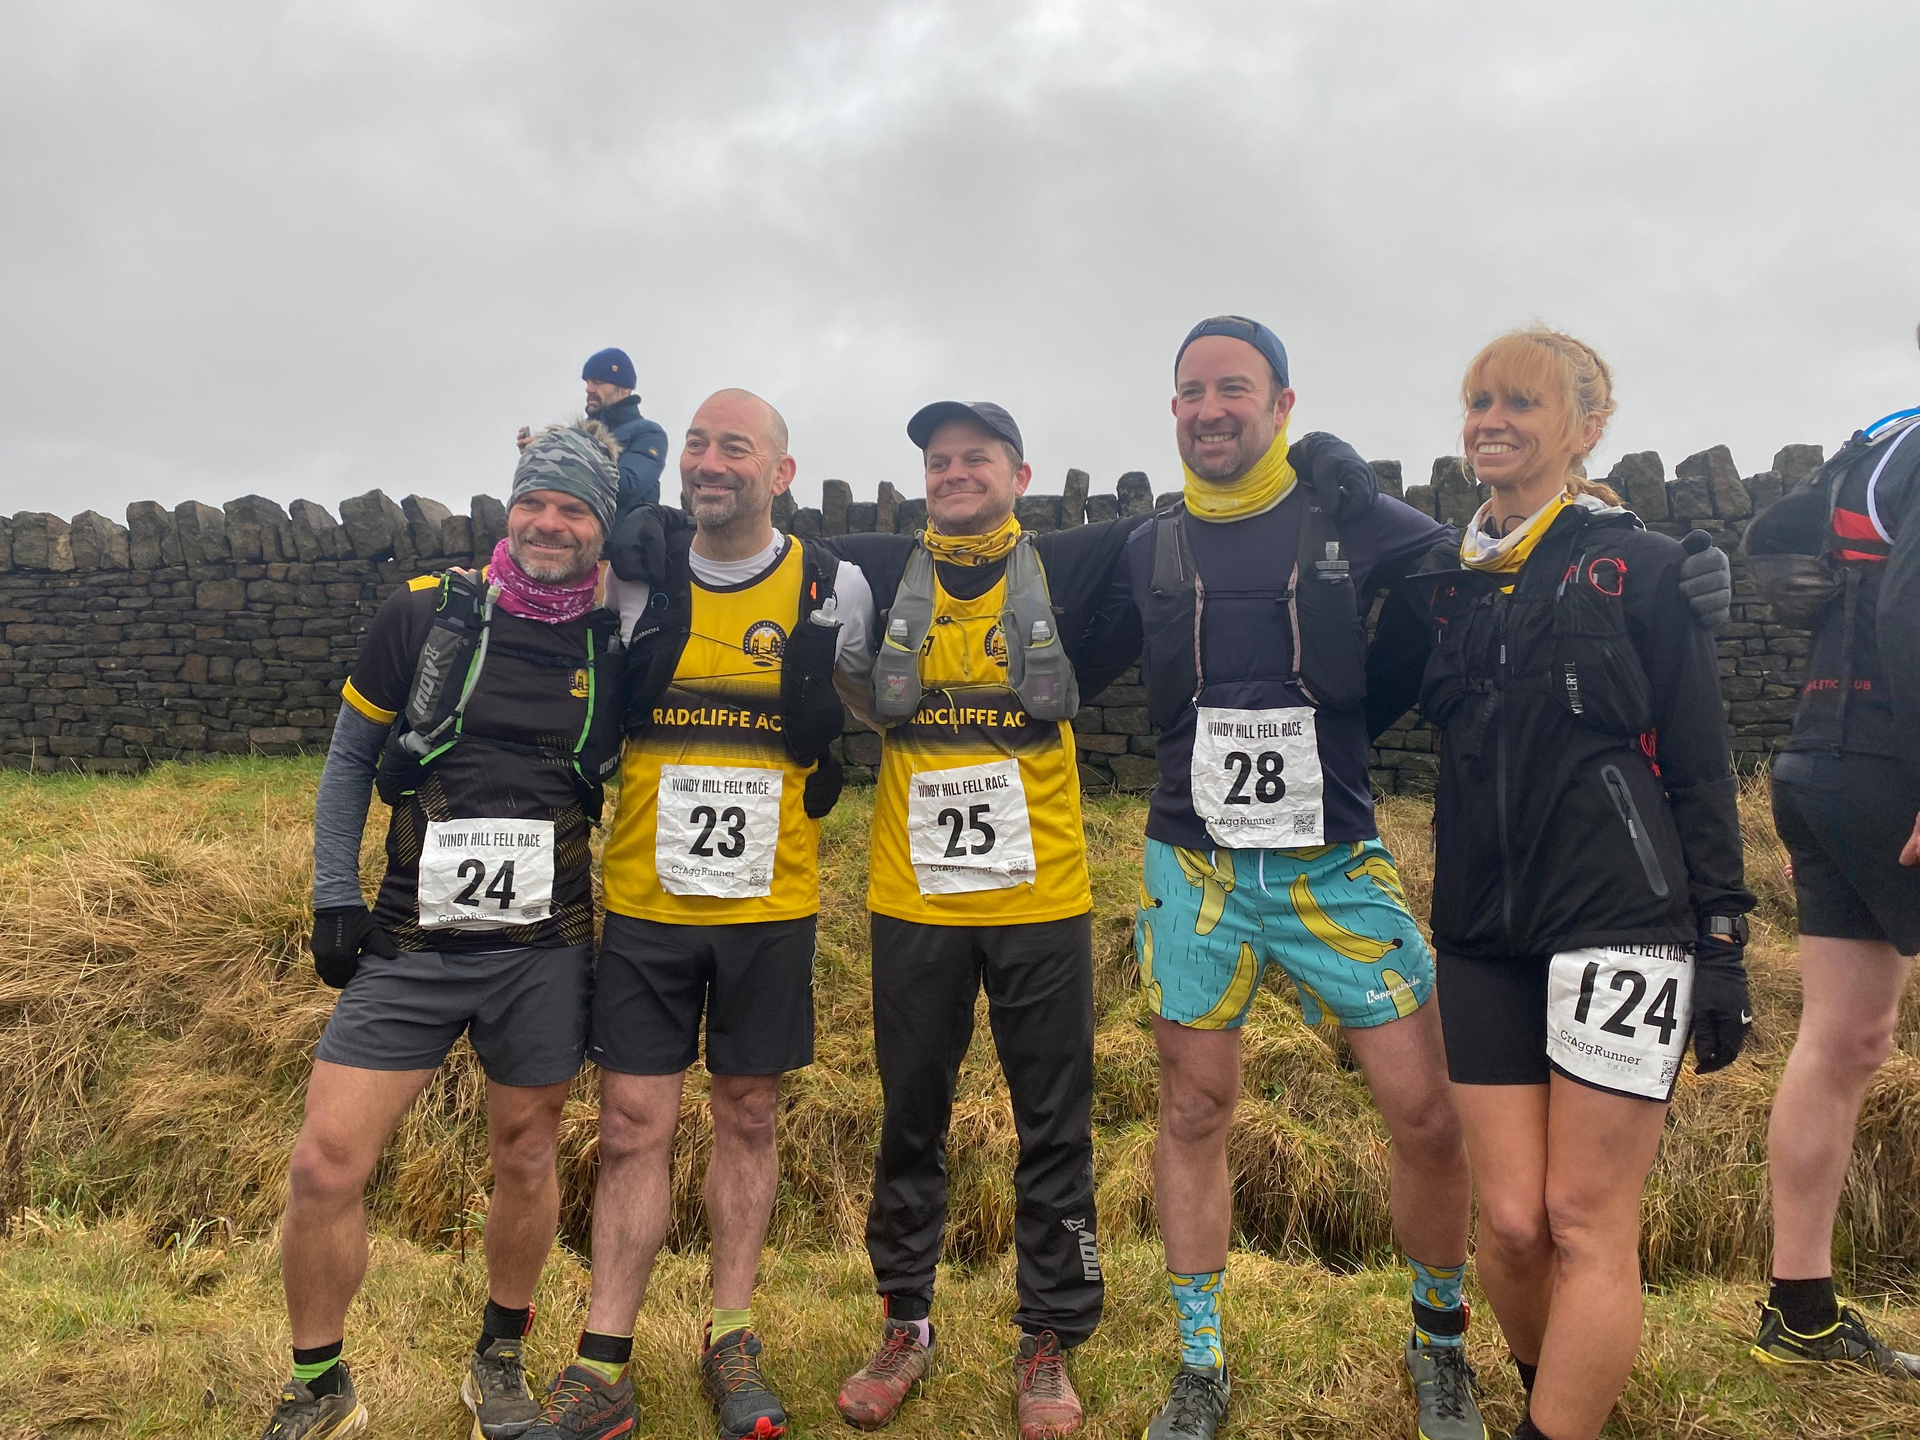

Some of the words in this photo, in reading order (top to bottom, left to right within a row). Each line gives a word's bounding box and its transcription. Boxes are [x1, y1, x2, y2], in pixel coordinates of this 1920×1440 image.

[652, 708, 751, 728] RADCLIFFE
[754, 713, 782, 732] AC
[1002, 711, 1026, 728] AC
[1208, 722, 1234, 738] WINDY
[1236, 724, 1254, 739] HILL
[1257, 723, 1279, 738] FELL
[1282, 721, 1302, 737] RACE
[672, 778, 700, 792] WINDY
[702, 779, 722, 794] HILL
[724, 780, 744, 794] FELL
[746, 781, 769, 795] RACE
[942, 782, 962, 796] HILL
[962, 779, 984, 794] FELL
[985, 774, 1010, 790] RACE
[1224, 751, 1286, 805] 28
[438, 833, 469, 848] WINDY
[470, 832, 491, 846] HILL
[494, 832, 514, 846] FELL
[517, 834, 541, 848] RACE
[688, 806, 746, 858] 23
[938, 804, 996, 858] 25
[453, 858, 516, 910] 24
[1640, 944, 1664, 959] FELL
[1574, 962, 1678, 1046] 124
[1560, 1030, 1642, 1066] CrAggRunner
[1606, 1062, 1640, 1074] THERE
